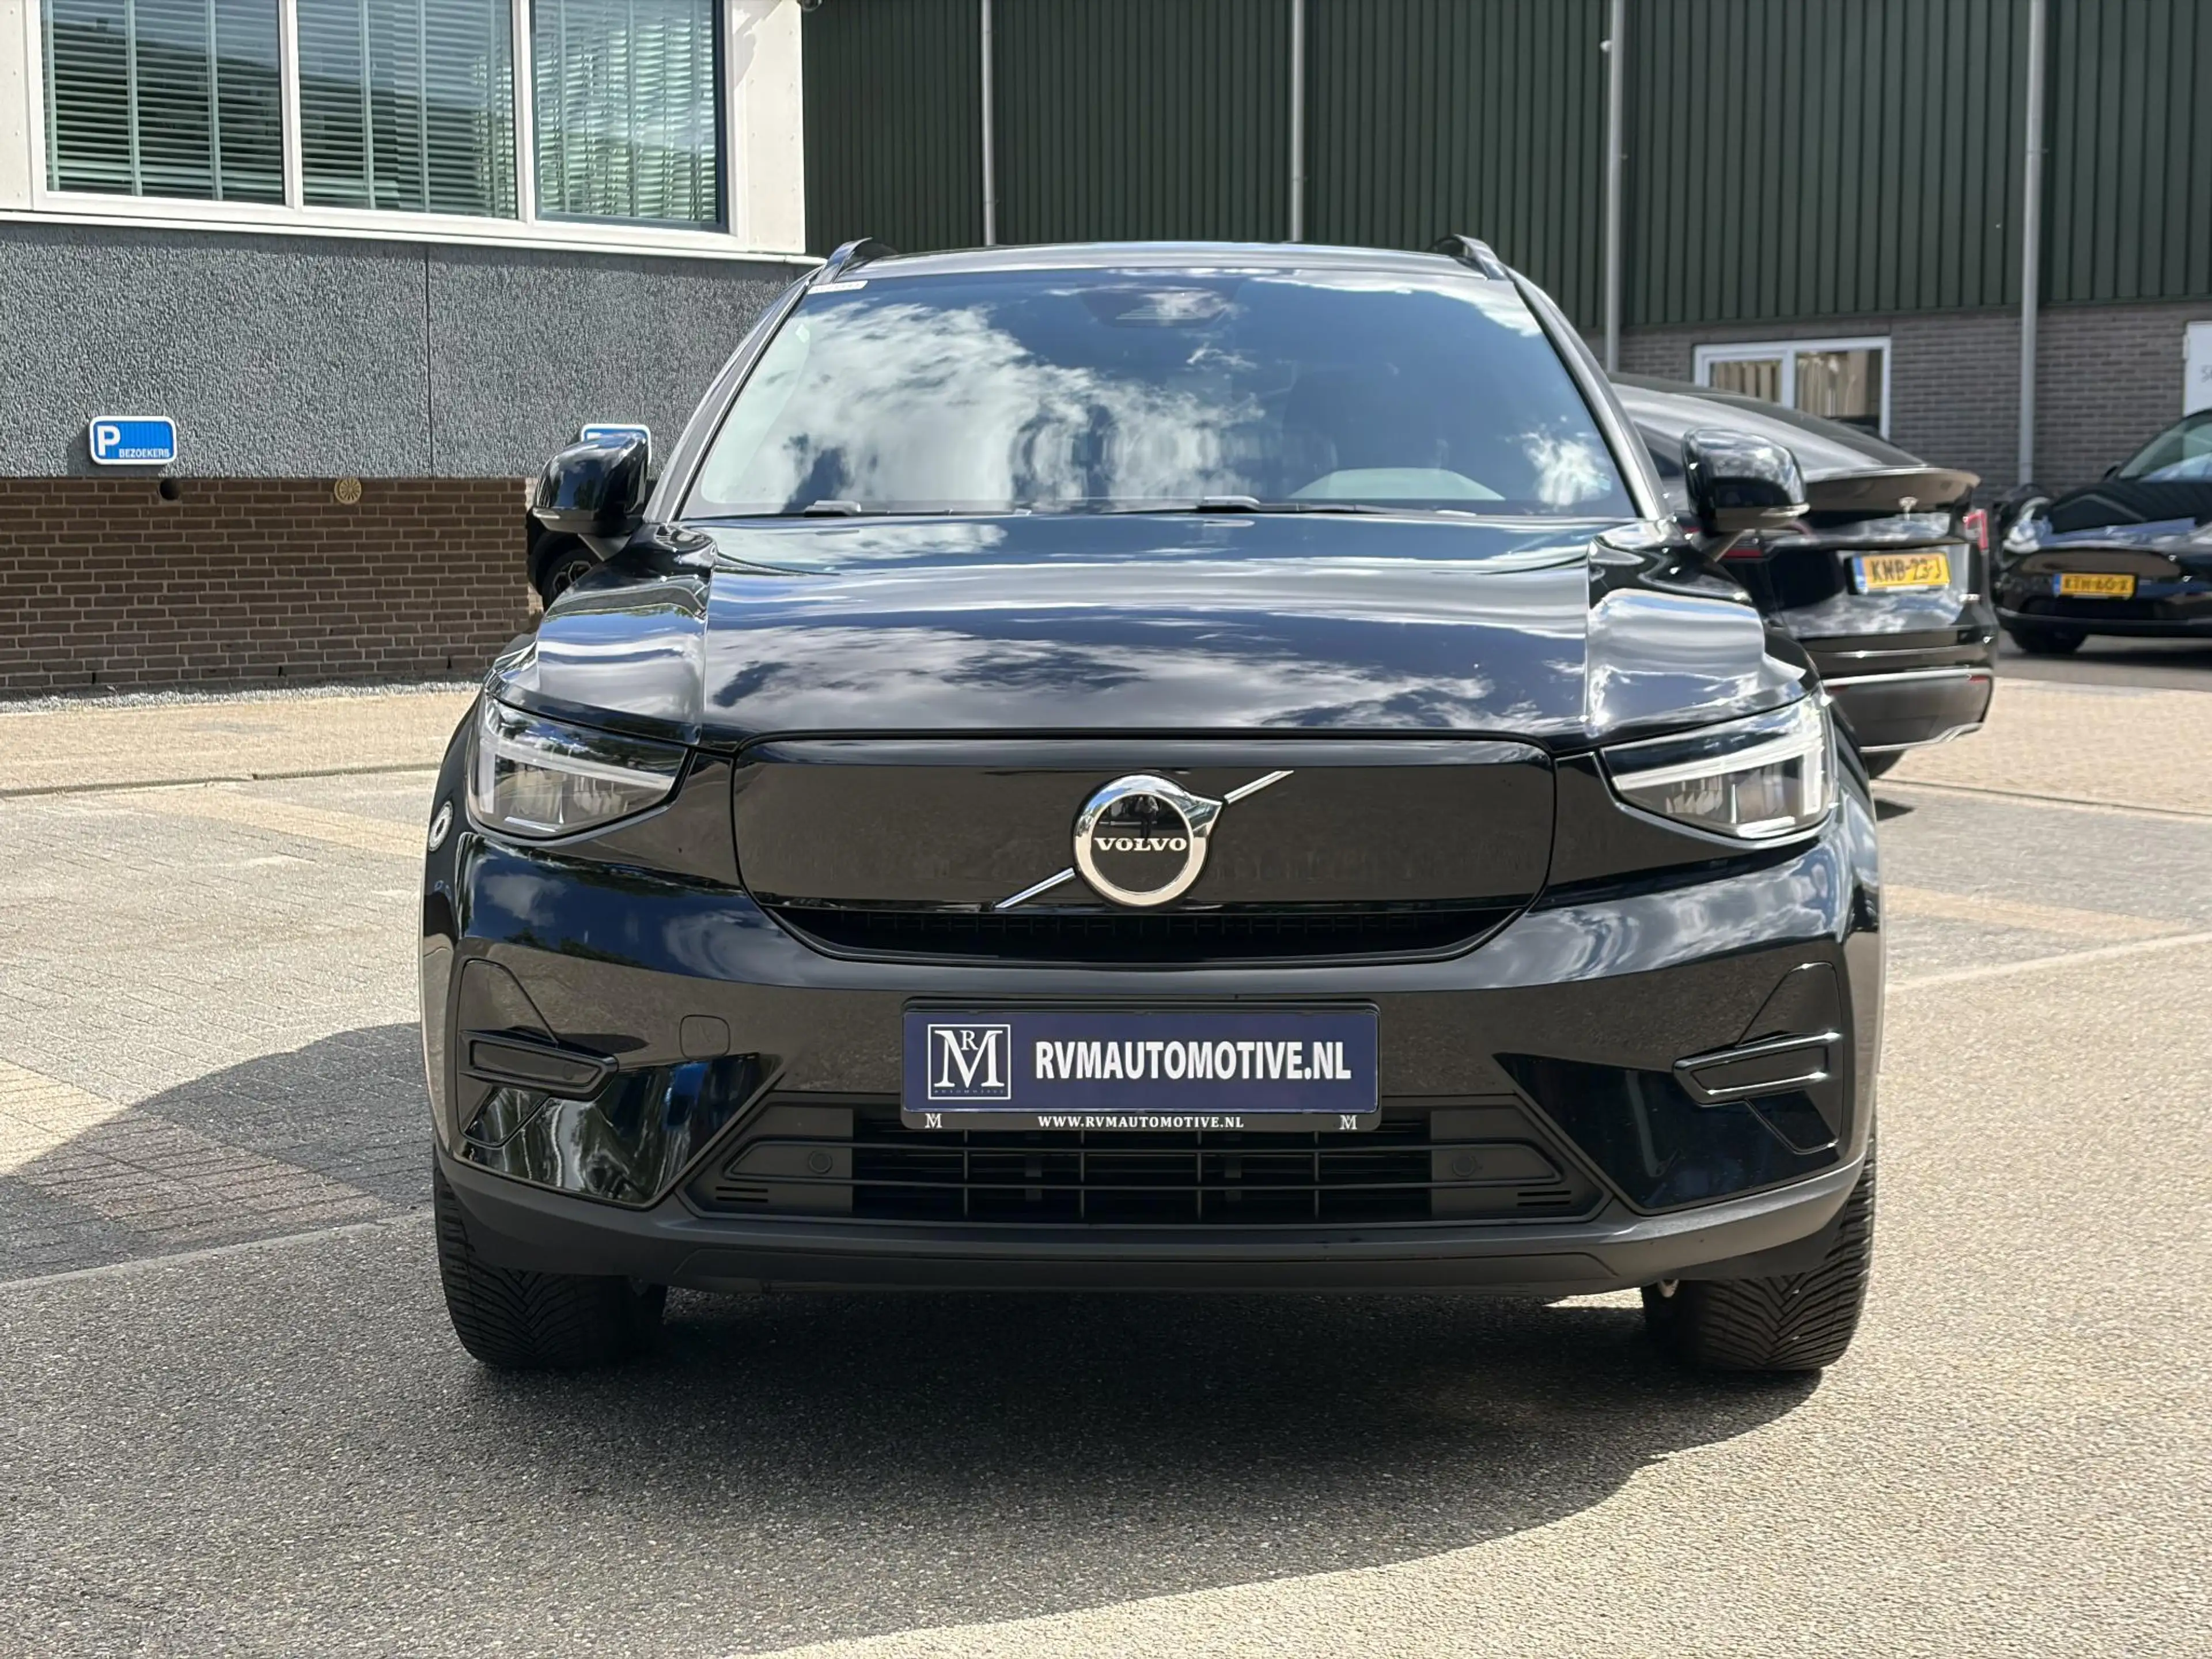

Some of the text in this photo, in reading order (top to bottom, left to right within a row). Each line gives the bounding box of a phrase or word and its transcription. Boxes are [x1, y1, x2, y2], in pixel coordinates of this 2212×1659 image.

[97, 425, 120, 456] P
[119, 448, 170, 458] BEZOEKERS
[1094, 838, 1187, 851] VOLVO
[1036, 1041, 1351, 1080] RVMAUTOMOTIVE.NL
[1038, 1115, 1244, 1128] WWW.RVMAUTOMOTIVE.NL
